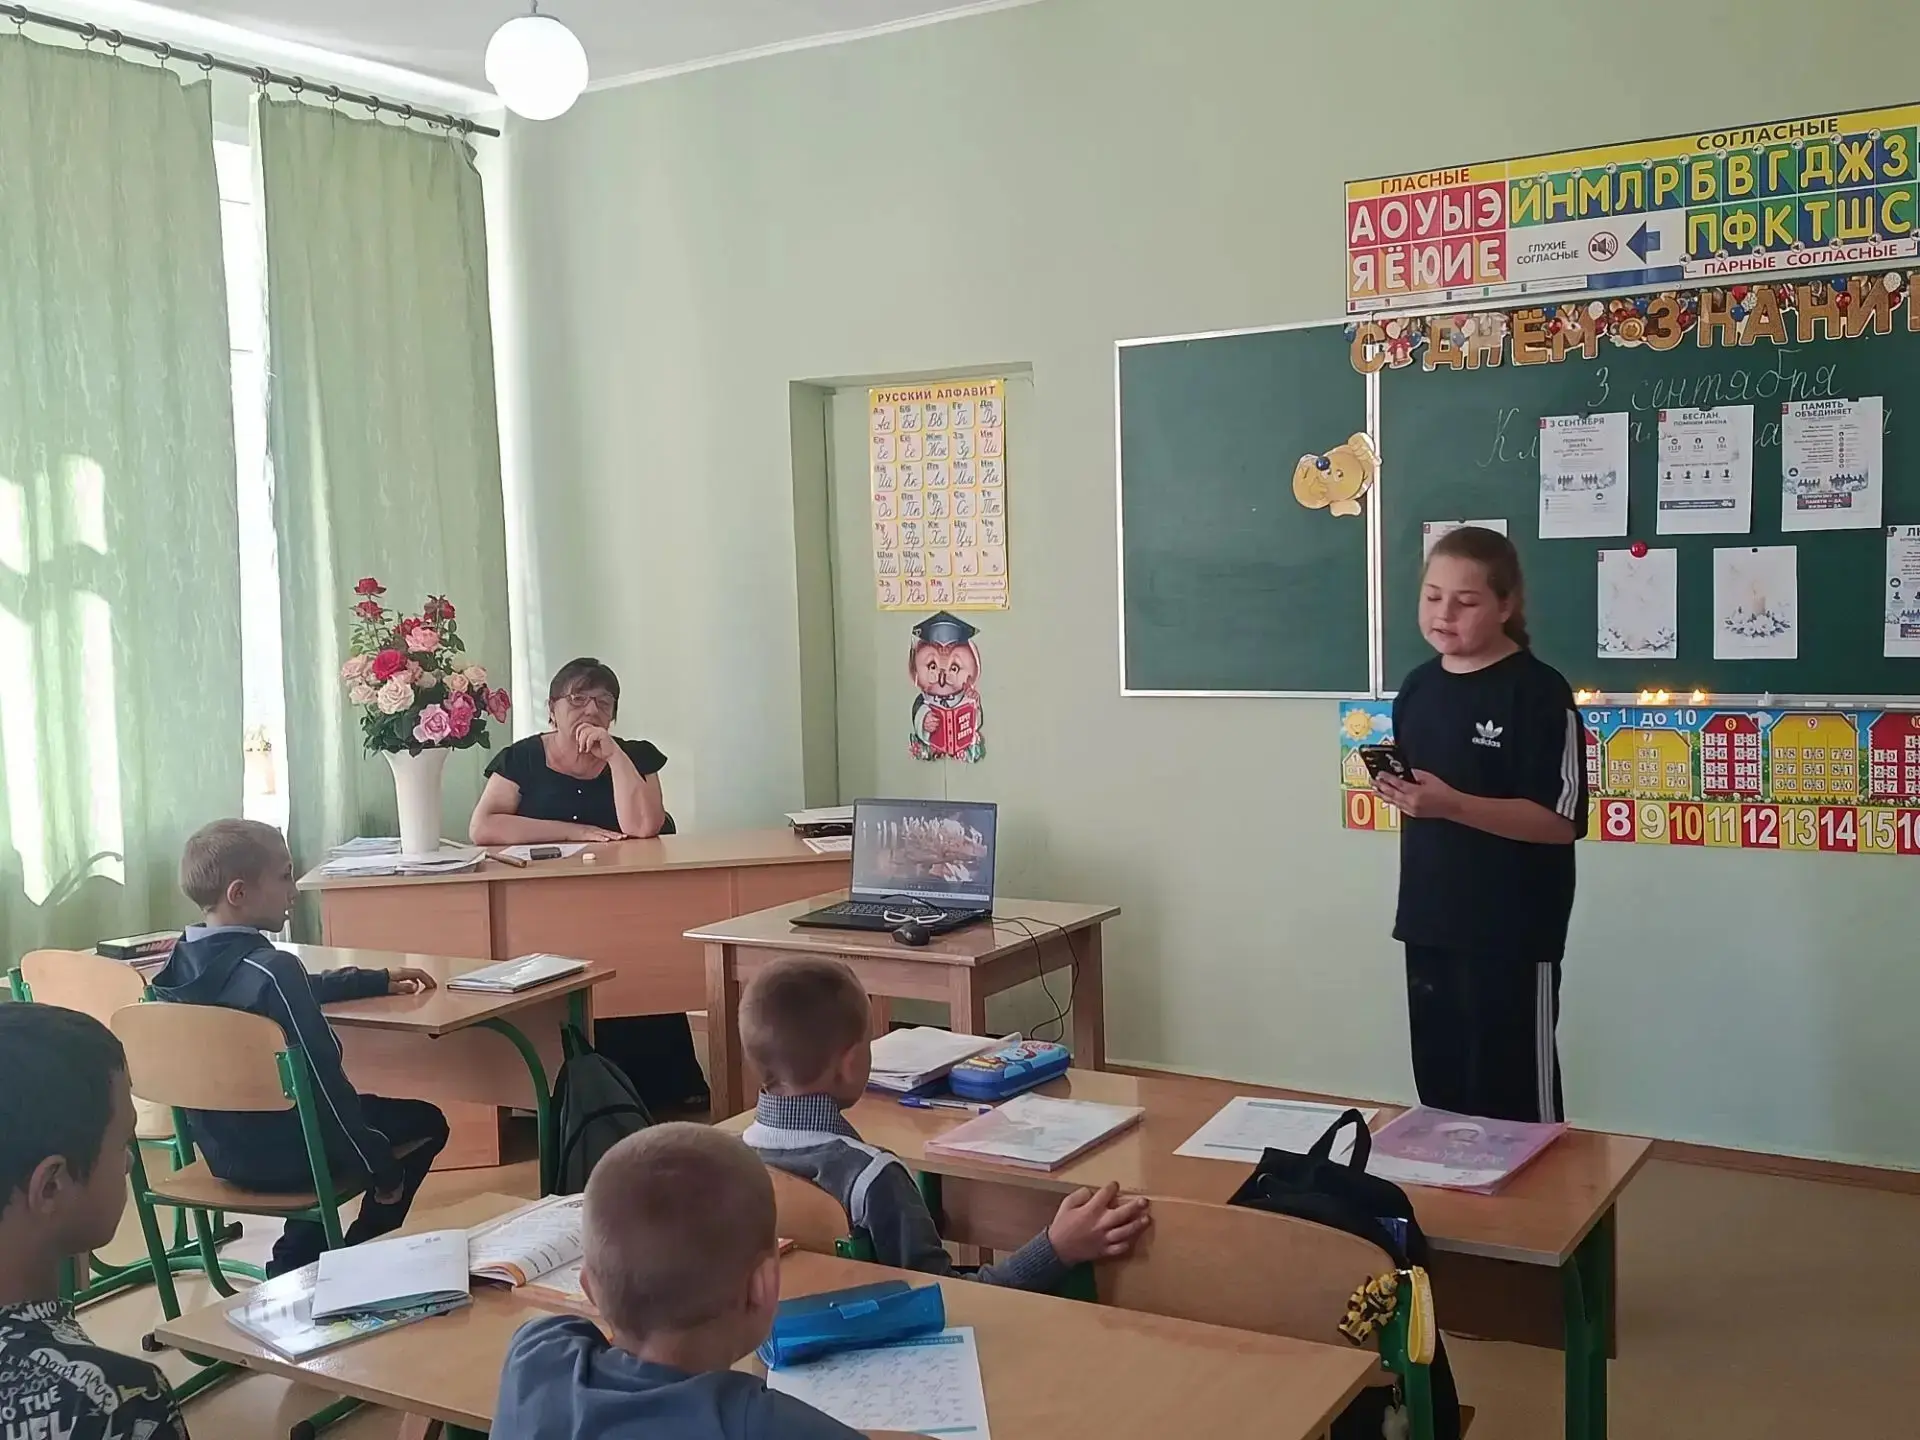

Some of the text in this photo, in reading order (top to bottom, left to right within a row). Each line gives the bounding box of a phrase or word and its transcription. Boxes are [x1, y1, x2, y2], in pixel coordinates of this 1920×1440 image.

[1697, 119, 1838, 150] СОГЛАСНЫЕ
[1381, 168, 1470, 194] ГЛАСНЫЕ
[1516, 250, 1579, 264] СОГЛАСНЫЕ
[1528, 241, 1567, 252] ГЛУХИЕ
[1704, 244, 1898, 275] ПАРНЫЕ СОГЛАСНЫЕ
[1350, 273, 1920, 374] С ДНЁМ ЗНАНИ
[937, 386, 996, 398] АЛФАВИТ
[1587, 366, 1610, 406] 3
[1794, 408, 1852, 418] ОБЪЕДИНЯЕТ
[1801, 400, 1844, 410] ПАМЯТЬ
[1550, 417, 1605, 428] 3 СЕНТЯБРЯ
[1588, 709, 1696, 727] от 1 до 10
[1351, 793, 1371, 825] 0
[1607, 802, 1631, 836] 8
[1640, 803, 1666, 838] 9
[1670, 806, 1702, 840] 10
[1708, 806, 1736, 842] 11
[1743, 808, 1778, 844] 12
[1782, 808, 1817, 846] 13
[1820, 810, 1856, 847] 14
[1860, 811, 1896, 848] 15
[19, 1385, 62, 1415] THE
